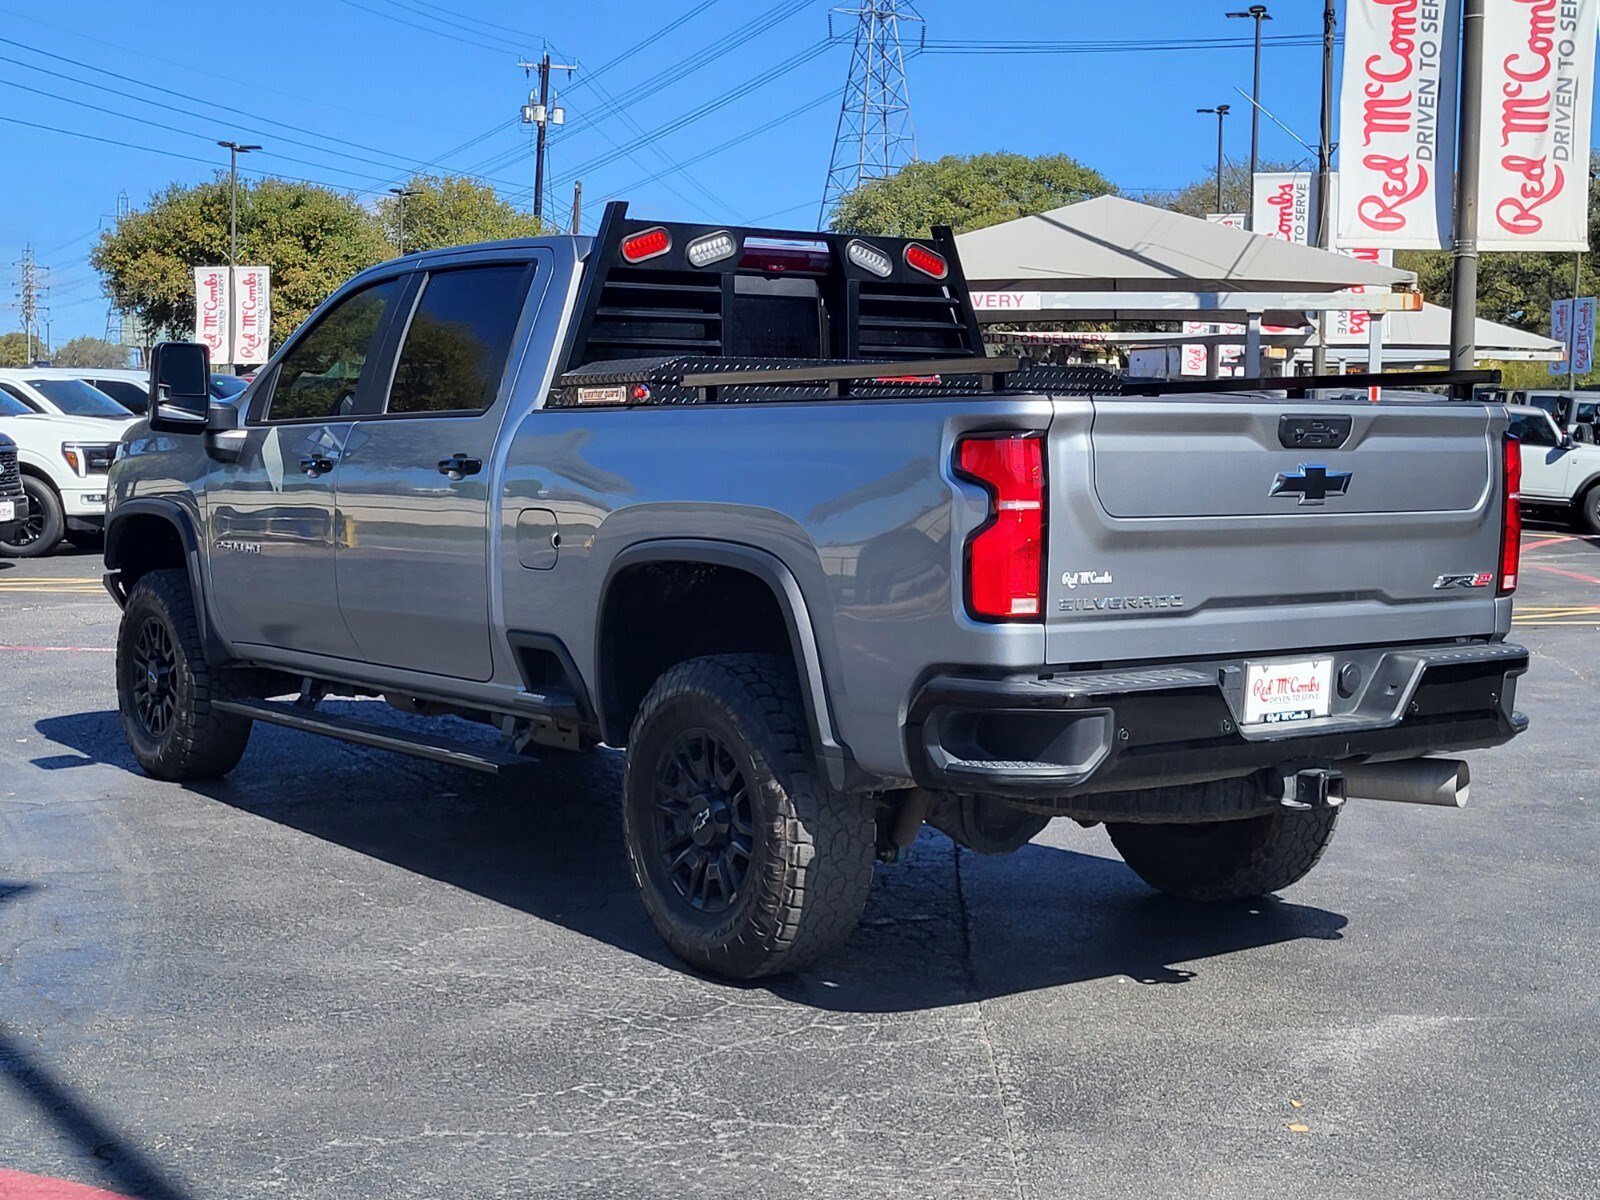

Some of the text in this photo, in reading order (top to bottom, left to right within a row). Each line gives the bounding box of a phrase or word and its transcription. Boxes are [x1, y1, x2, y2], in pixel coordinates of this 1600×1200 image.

[1558, 39, 1576, 70] TO
[1361, 0, 1418, 147] McCom
[1416, 0, 1440, 162] DRIVEN TO SER
[1496, 0, 1565, 235] Red McCom
[1552, 77, 1574, 161] DRIVEN
[1358, 154, 1429, 232] Red
[1267, 183, 1294, 242] ombs
[1294, 183, 1306, 243] TO SERVE
[203, 273, 218, 331] McCombs
[219, 297, 225, 307] TO
[240, 272, 262, 358] Red McCombs
[258, 296, 264, 307] TO
[972, 294, 1025, 308] VERY
[983, 334, 1108, 344] OLD FOR DELIVERY
[1187, 348, 1207, 371] Red
[1061, 570, 1113, 590] Red McCombs
[1058, 594, 1185, 612] SILVERADO
[1253, 675, 1320, 703] Red McCombs
[1269, 692, 1319, 704] DRIVEN TO SERVE
